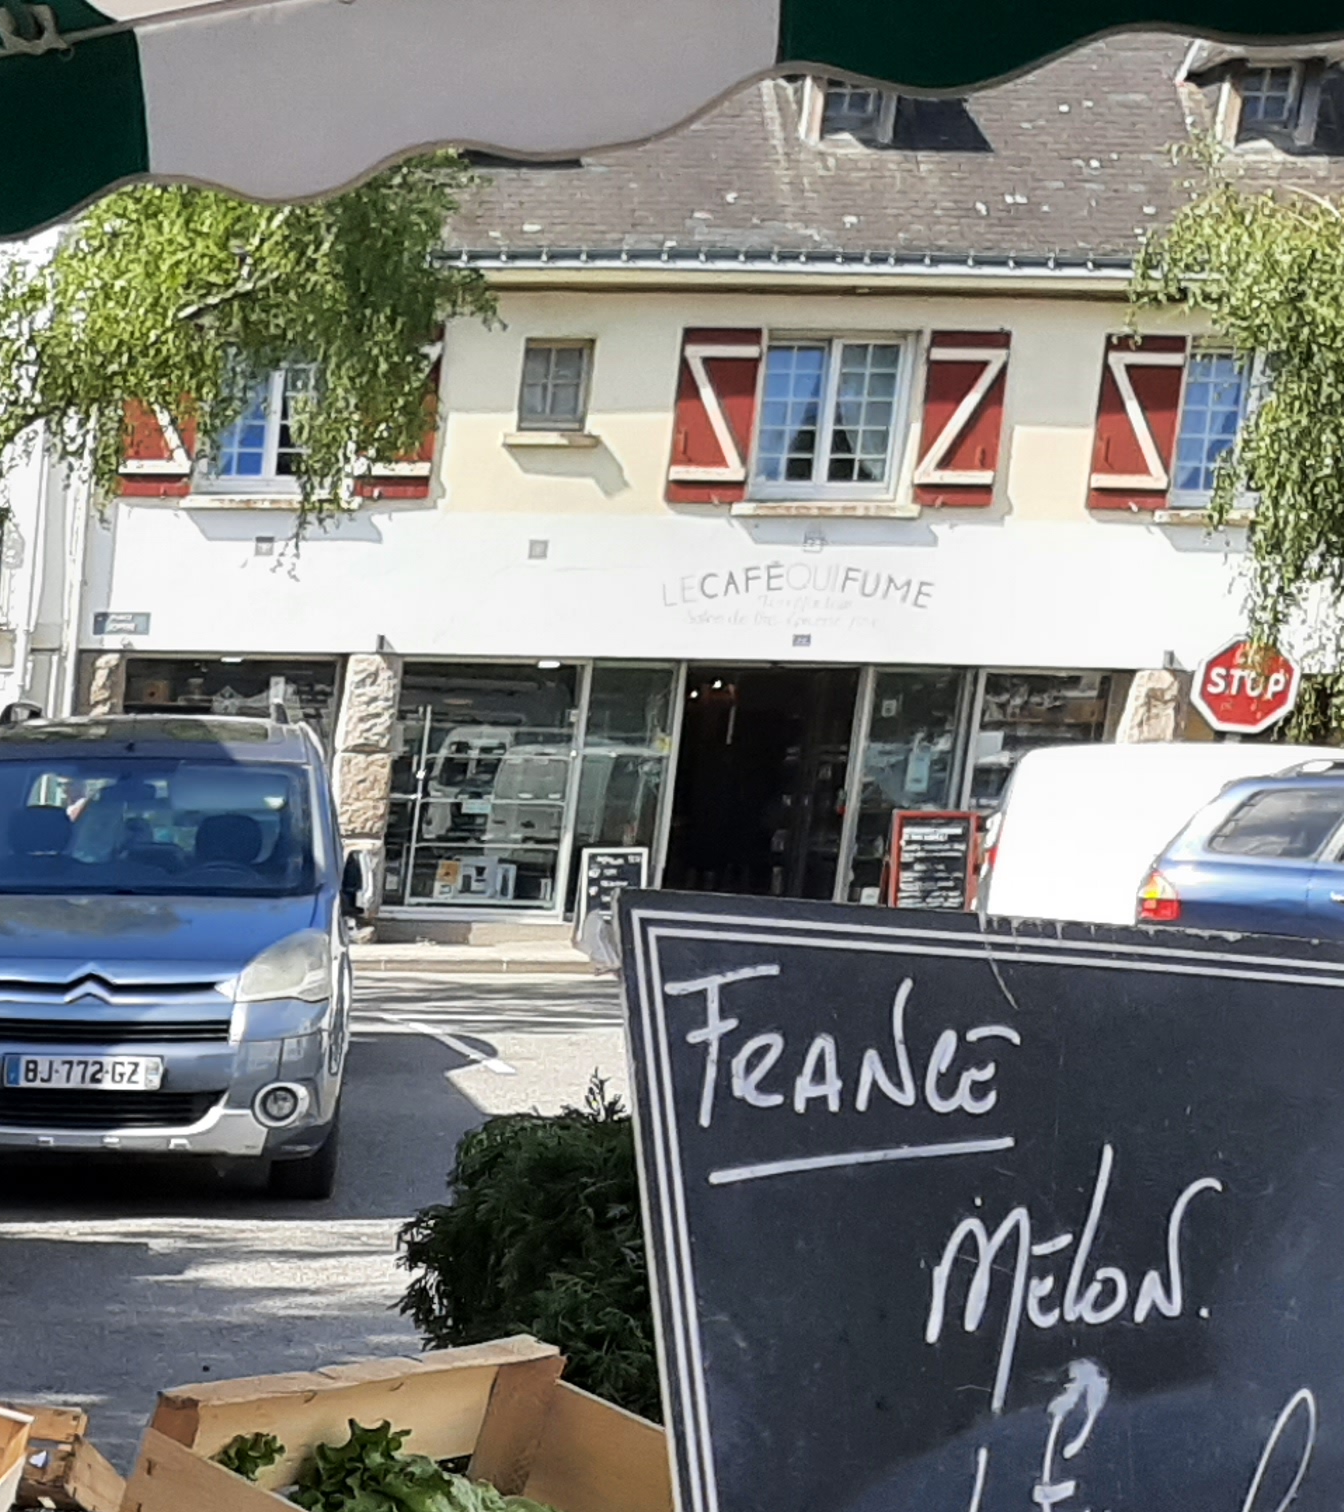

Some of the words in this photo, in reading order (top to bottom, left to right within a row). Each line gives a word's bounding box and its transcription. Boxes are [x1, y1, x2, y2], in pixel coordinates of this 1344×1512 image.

[841, 566, 935, 609] FUME
[1206, 666, 1287, 701] STOP
[24, 1059, 140, 1084] BJ-772-GZ
